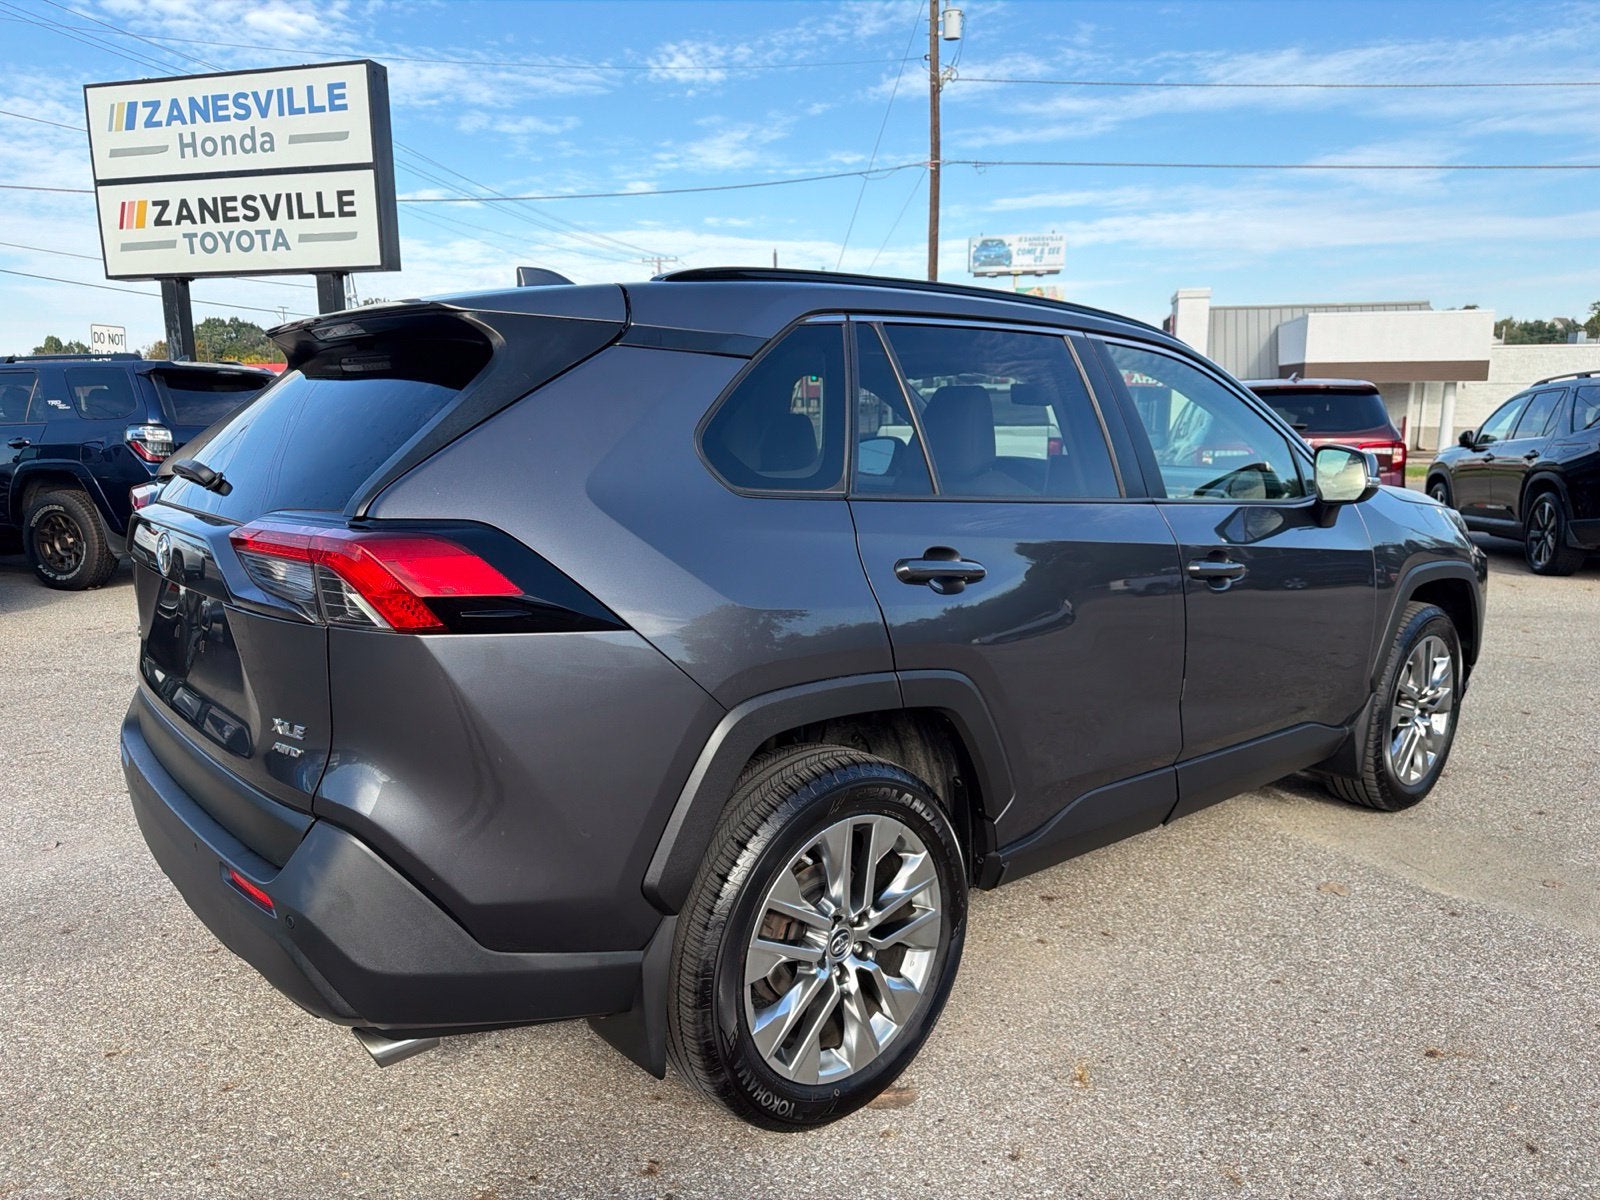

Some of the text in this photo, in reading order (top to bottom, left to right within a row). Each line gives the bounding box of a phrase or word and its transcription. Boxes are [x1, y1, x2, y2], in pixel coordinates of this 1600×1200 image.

[141, 82, 348, 129] ZANESVILLE
[178, 126, 275, 159] Honda
[151, 189, 357, 227] ZANESVILLE
[182, 228, 291, 255] TOYOTA
[93, 331, 124, 346] DO NOT
[271, 717, 307, 741] XLE
